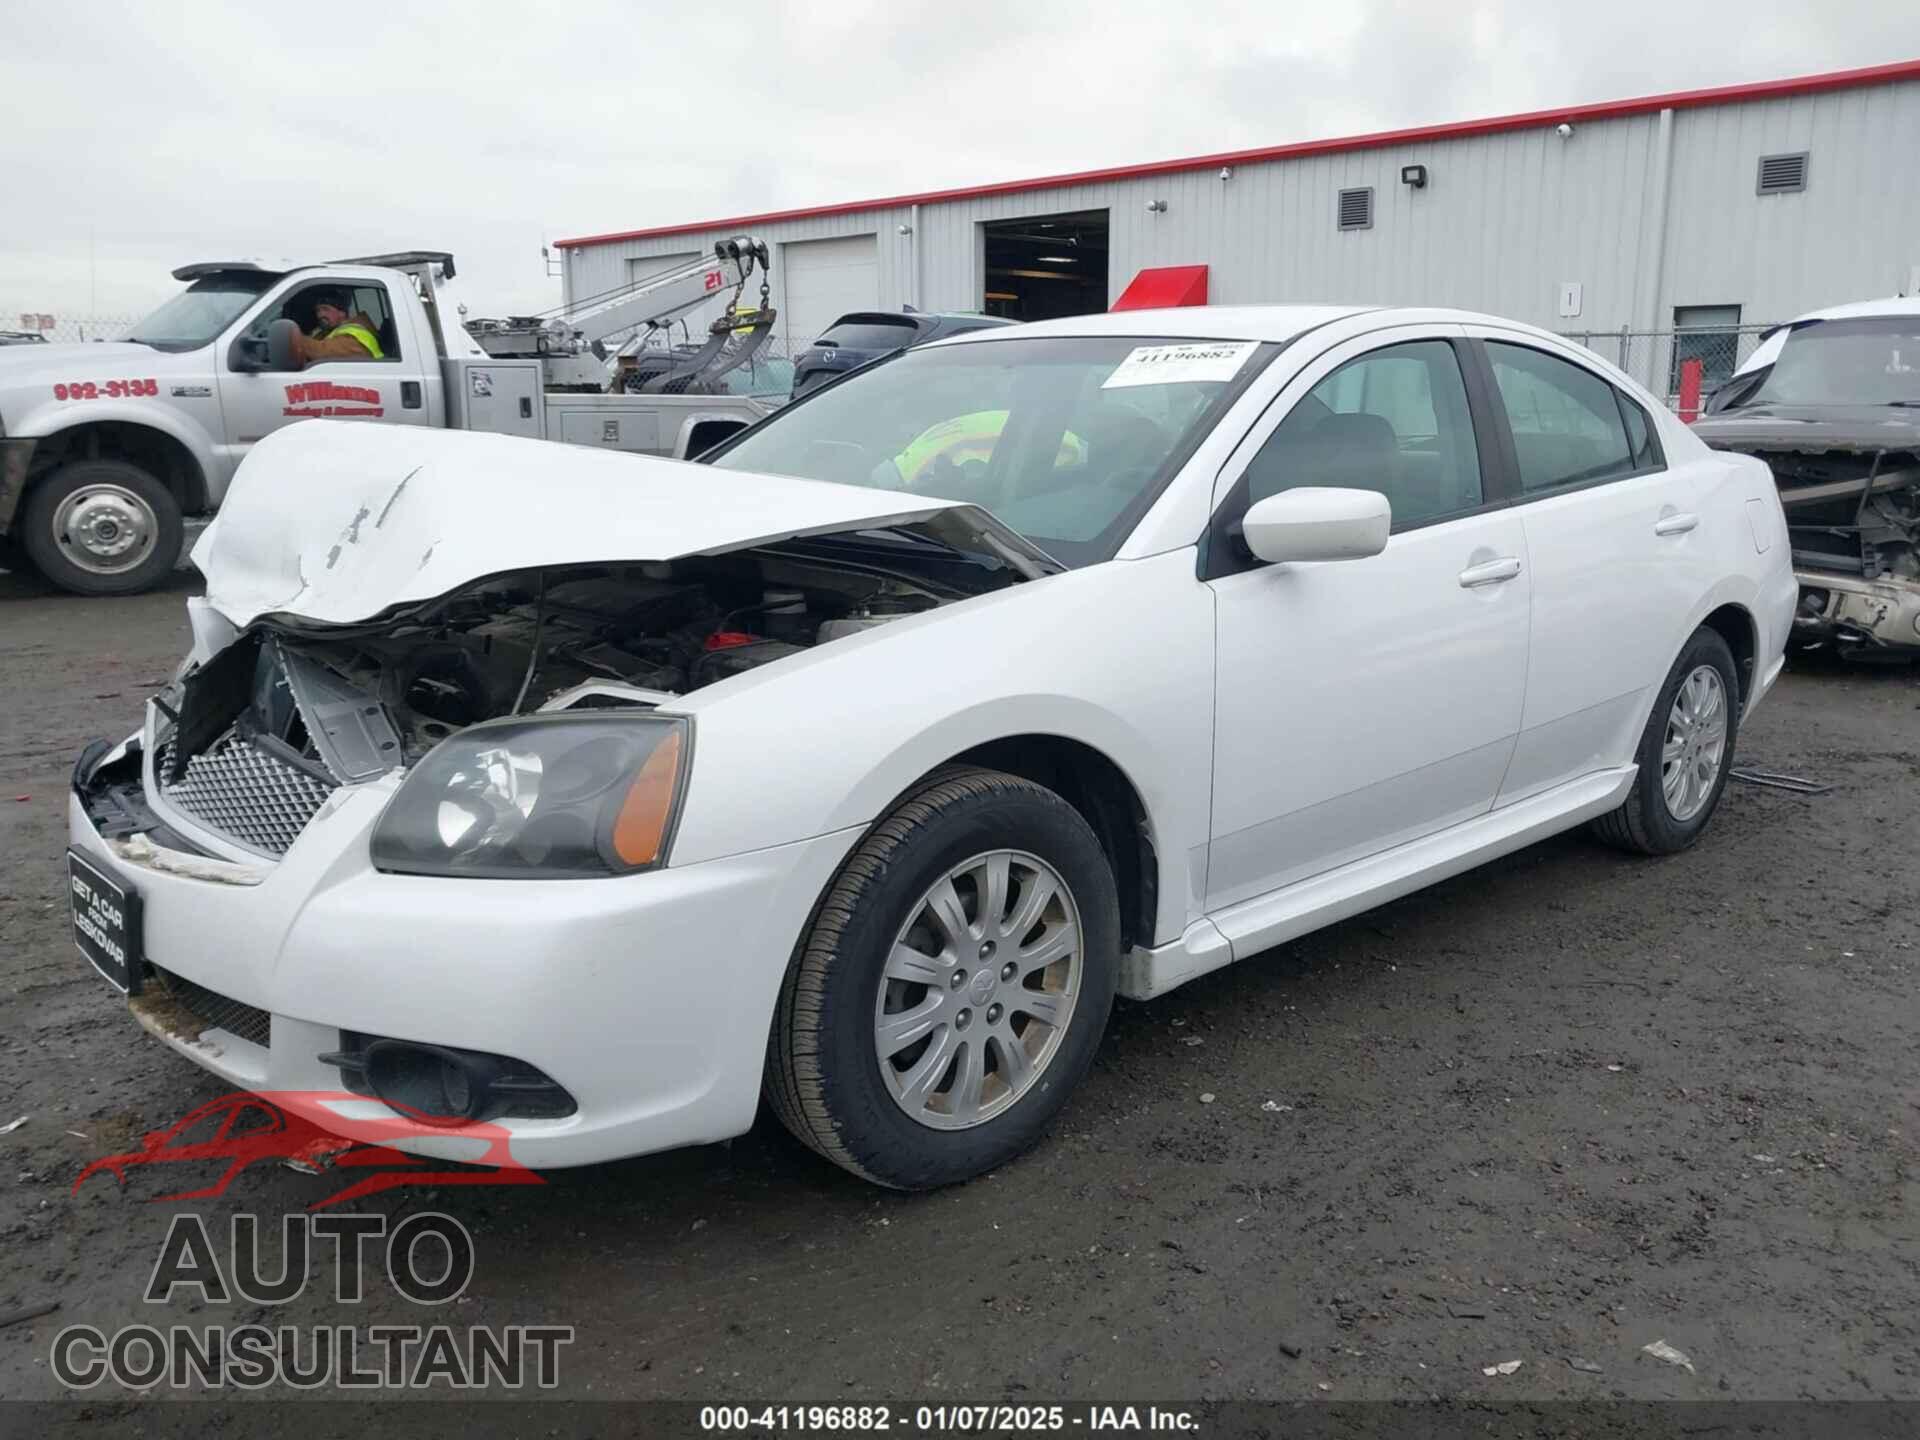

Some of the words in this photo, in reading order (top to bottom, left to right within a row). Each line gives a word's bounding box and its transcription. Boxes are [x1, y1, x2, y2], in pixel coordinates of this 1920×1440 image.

[705, 271, 721, 289] 21
[1136, 350, 1237, 364] 41196882
[53, 378, 160, 401] 992-3135
[72, 875, 92, 903] GET
[91, 892, 101, 912] A
[100, 898, 124, 931] CAR
[87, 905, 109, 931] FROM
[73, 907, 125, 968] LESKOVAR
